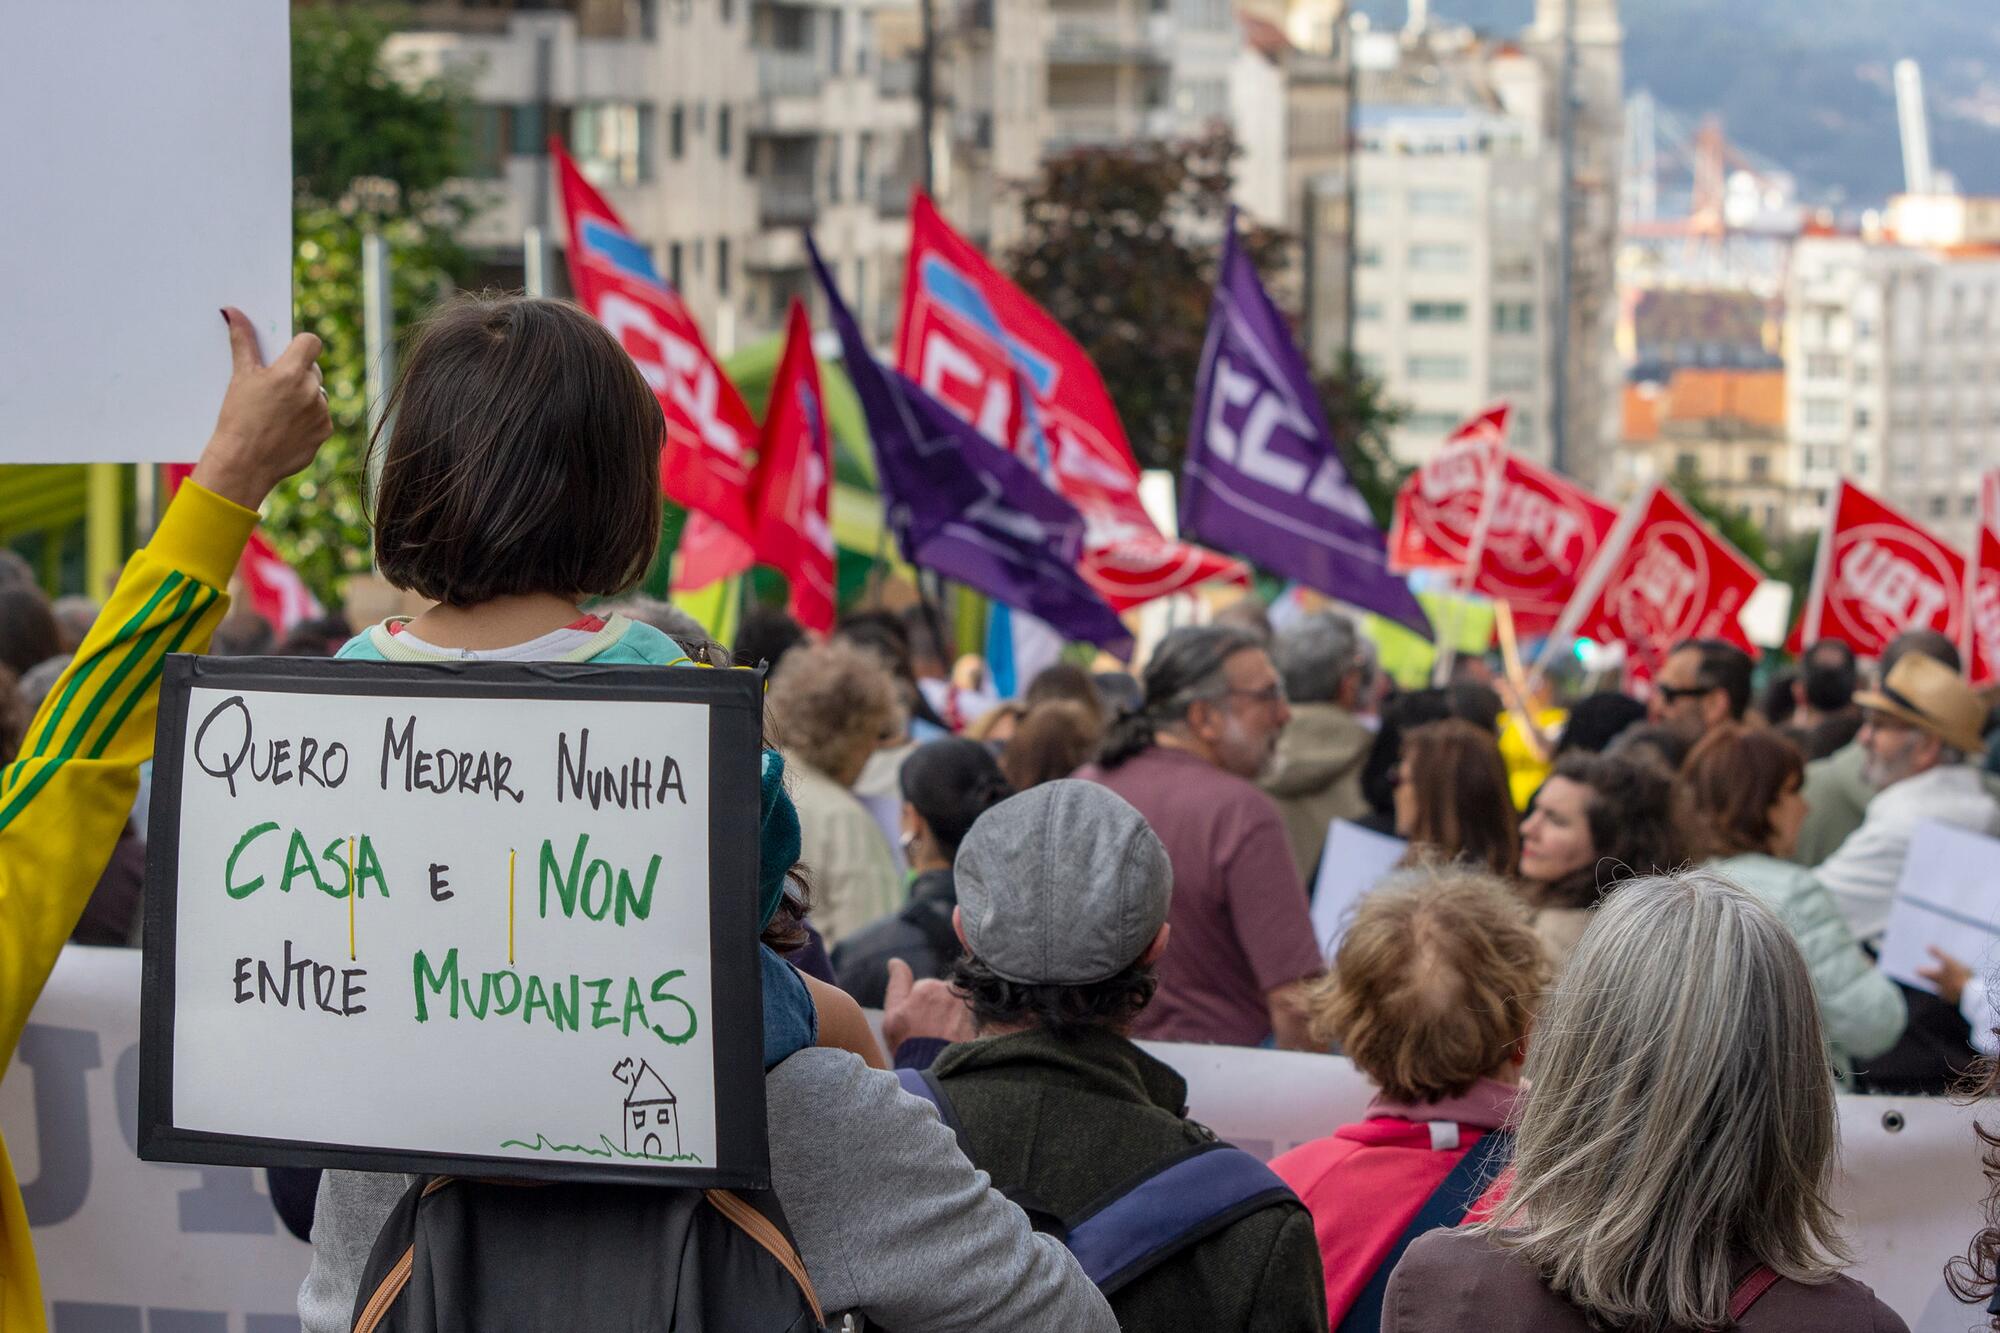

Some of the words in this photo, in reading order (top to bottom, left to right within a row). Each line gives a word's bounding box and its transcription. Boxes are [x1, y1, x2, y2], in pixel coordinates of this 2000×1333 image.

[1841, 538, 1945, 634] UGT
[194, 695, 349, 798] QUERO
[380, 714, 525, 803] MEDRAR
[557, 727, 688, 811] NUNHA
[225, 821, 391, 900] CASA
[428, 862, 455, 902] E
[539, 832, 663, 928] NON
[232, 939, 368, 1018] ENTRE
[413, 947, 699, 1046] MUDANZAS
